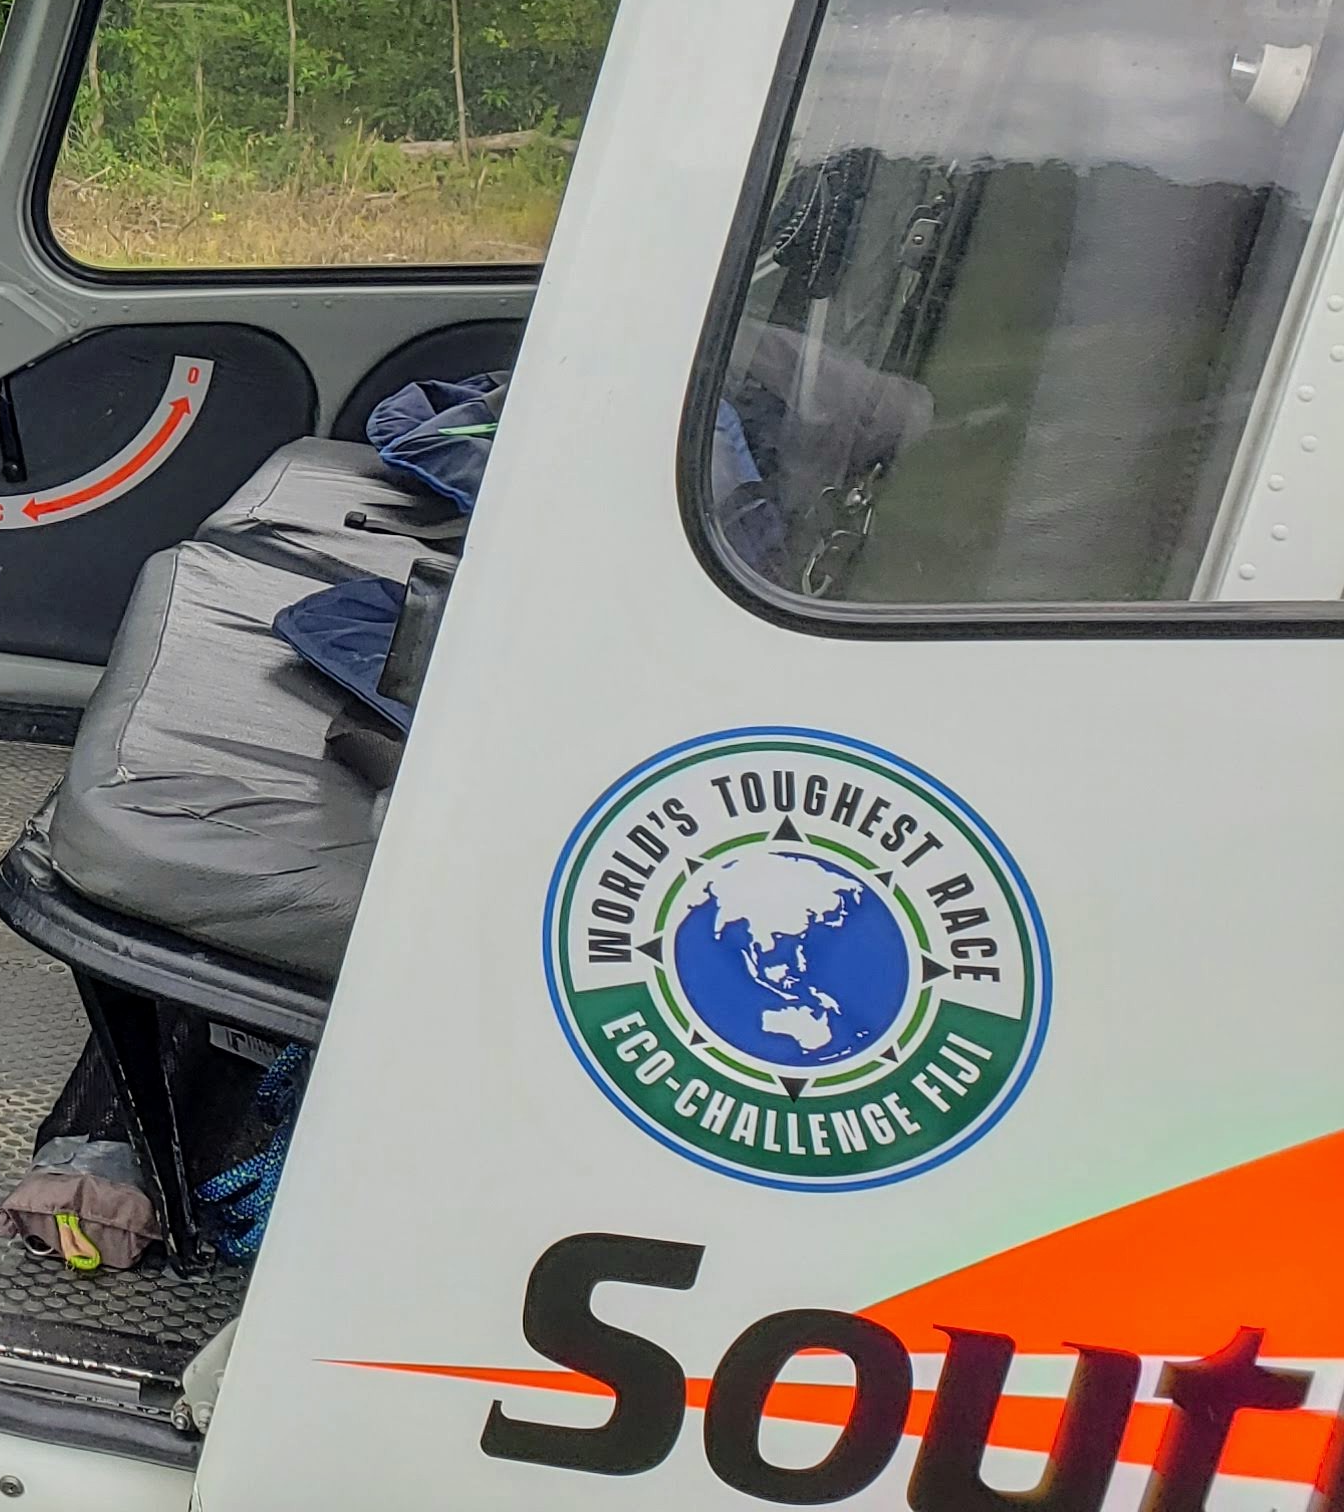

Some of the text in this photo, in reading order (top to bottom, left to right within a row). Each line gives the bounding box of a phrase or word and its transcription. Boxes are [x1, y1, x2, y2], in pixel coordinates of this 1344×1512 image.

[589, 770, 1000, 983] WORLD'S TOUGHEST RACE
[601, 1010, 993, 1156] ECO-CHALLENGE FIJI
[480, 1232, 1344, 1512] Sout
